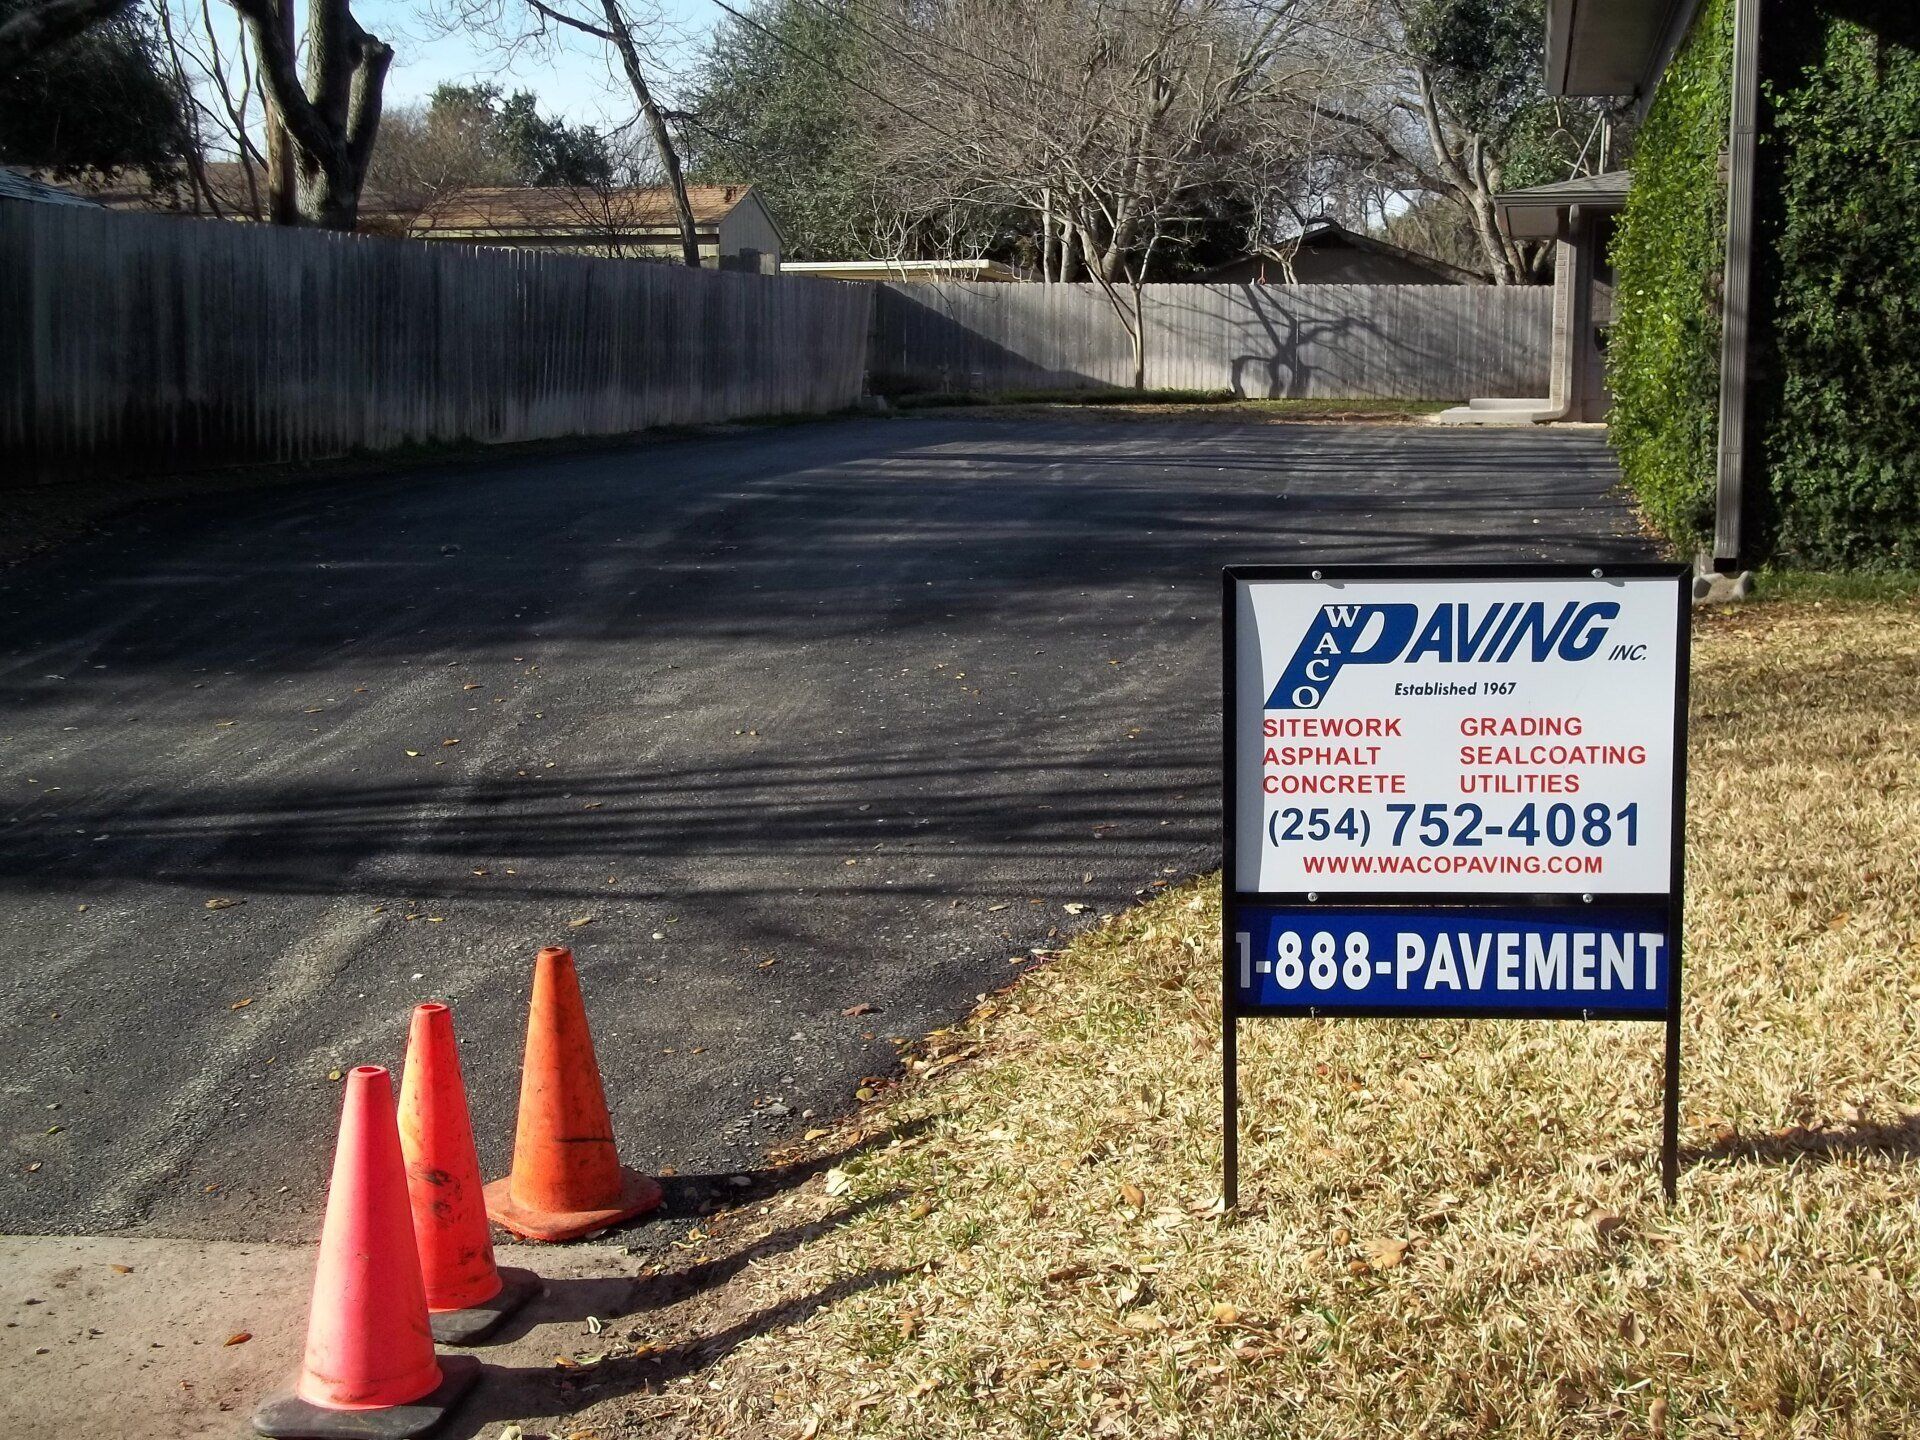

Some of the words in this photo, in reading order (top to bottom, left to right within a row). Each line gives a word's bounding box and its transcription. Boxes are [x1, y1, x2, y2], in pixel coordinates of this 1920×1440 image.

[1263, 601, 1621, 709] PAVING
[1608, 644, 1647, 661] INC.
[1291, 605, 1362, 708] WACO
[1394, 682, 1477, 696] Established
[1482, 682, 1517, 696] 1967
[1262, 718, 1402, 738] SITEWORK
[1460, 717, 1582, 736] GRADING
[1262, 746, 1381, 766] ASPHALT
[1460, 745, 1647, 765] SEALCOATING
[1262, 774, 1406, 794] CONCRETE
[1460, 774, 1580, 794] UTILITIES
[1268, 808, 1371, 847] (254)
[1386, 802, 1639, 848] 752-4081
[1303, 856, 1603, 875] WWW.WACOPAVING.COM
[1236, 931, 1664, 990] 1-888-PAVEMENT
